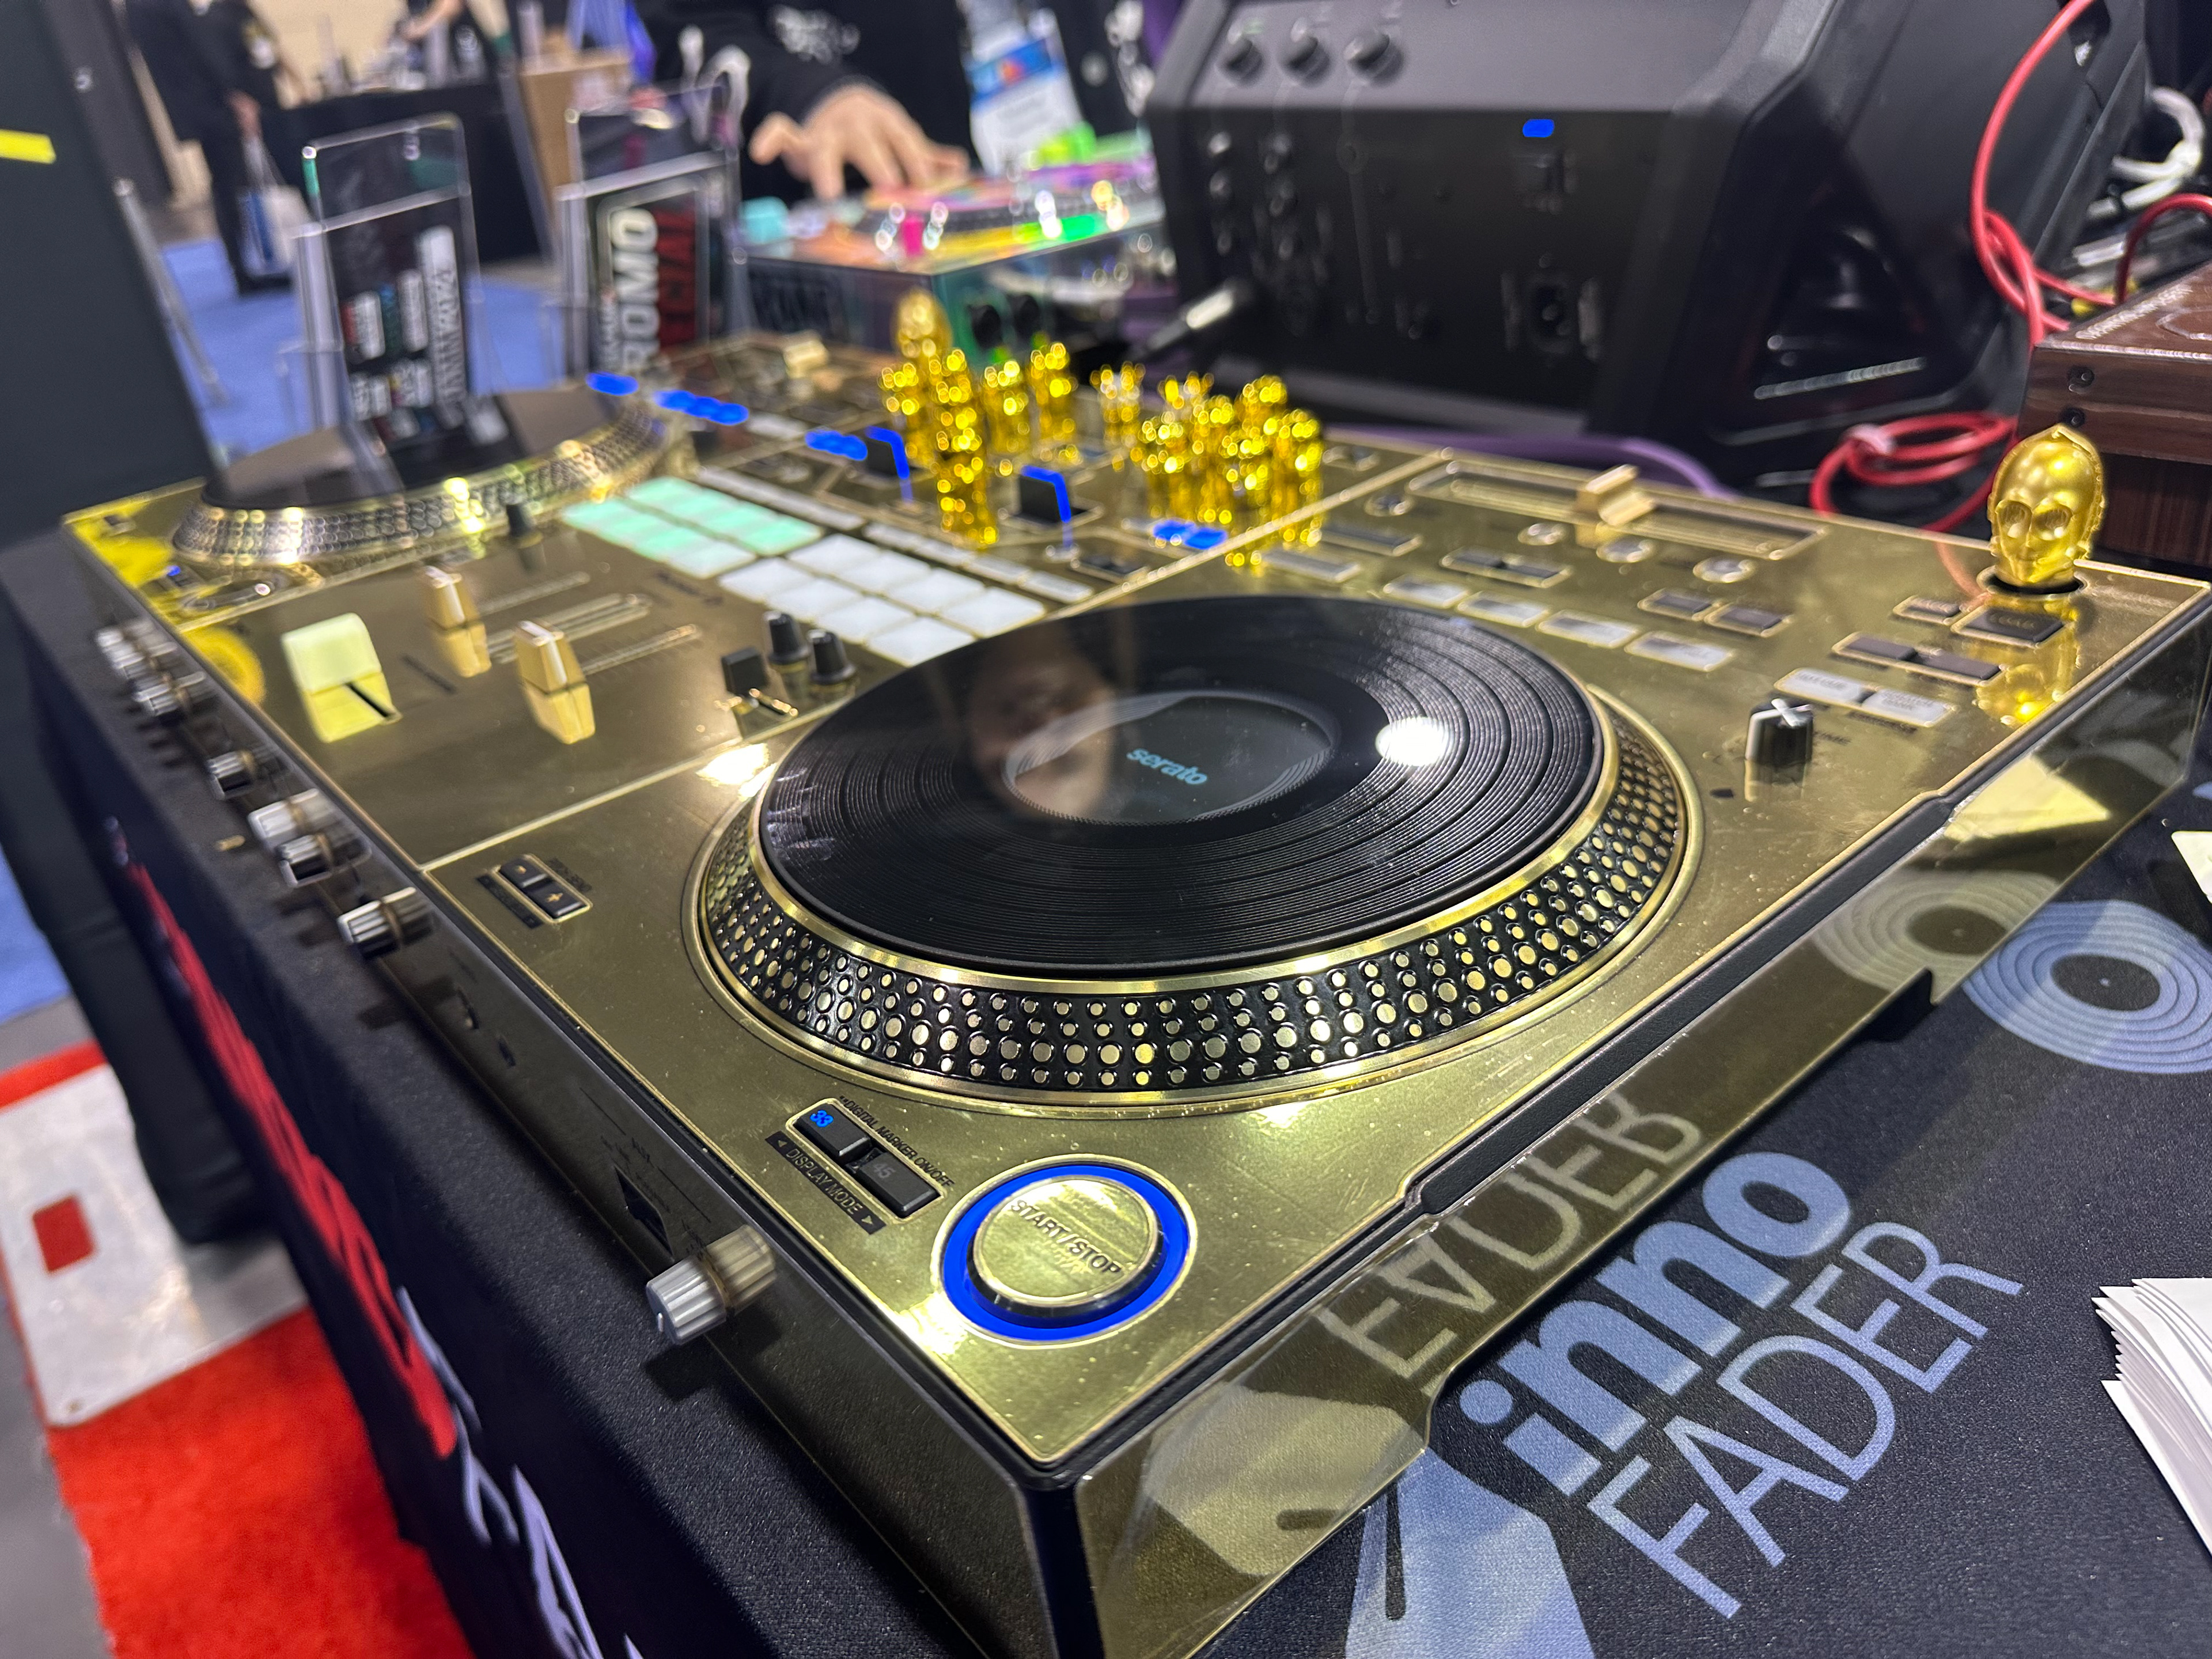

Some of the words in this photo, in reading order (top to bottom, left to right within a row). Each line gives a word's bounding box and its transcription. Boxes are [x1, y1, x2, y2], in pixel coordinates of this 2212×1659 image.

[1126, 748, 1207, 785] serato
[810, 1110, 834, 1127] 33
[843, 1100, 878, 1129] DIGITAL
[876, 1126, 918, 1160] MARKER
[914, 1157, 955, 1187] ON/OFF
[786, 1148, 833, 1185] DISPLAY
[825, 1184, 863, 1215] MODE
[873, 1162, 896, 1179] 45
[1011, 1199, 1123, 1273] START/STOP
[1460, 1152, 1851, 1496] inno
[1588, 1222, 2023, 1618] FADER
